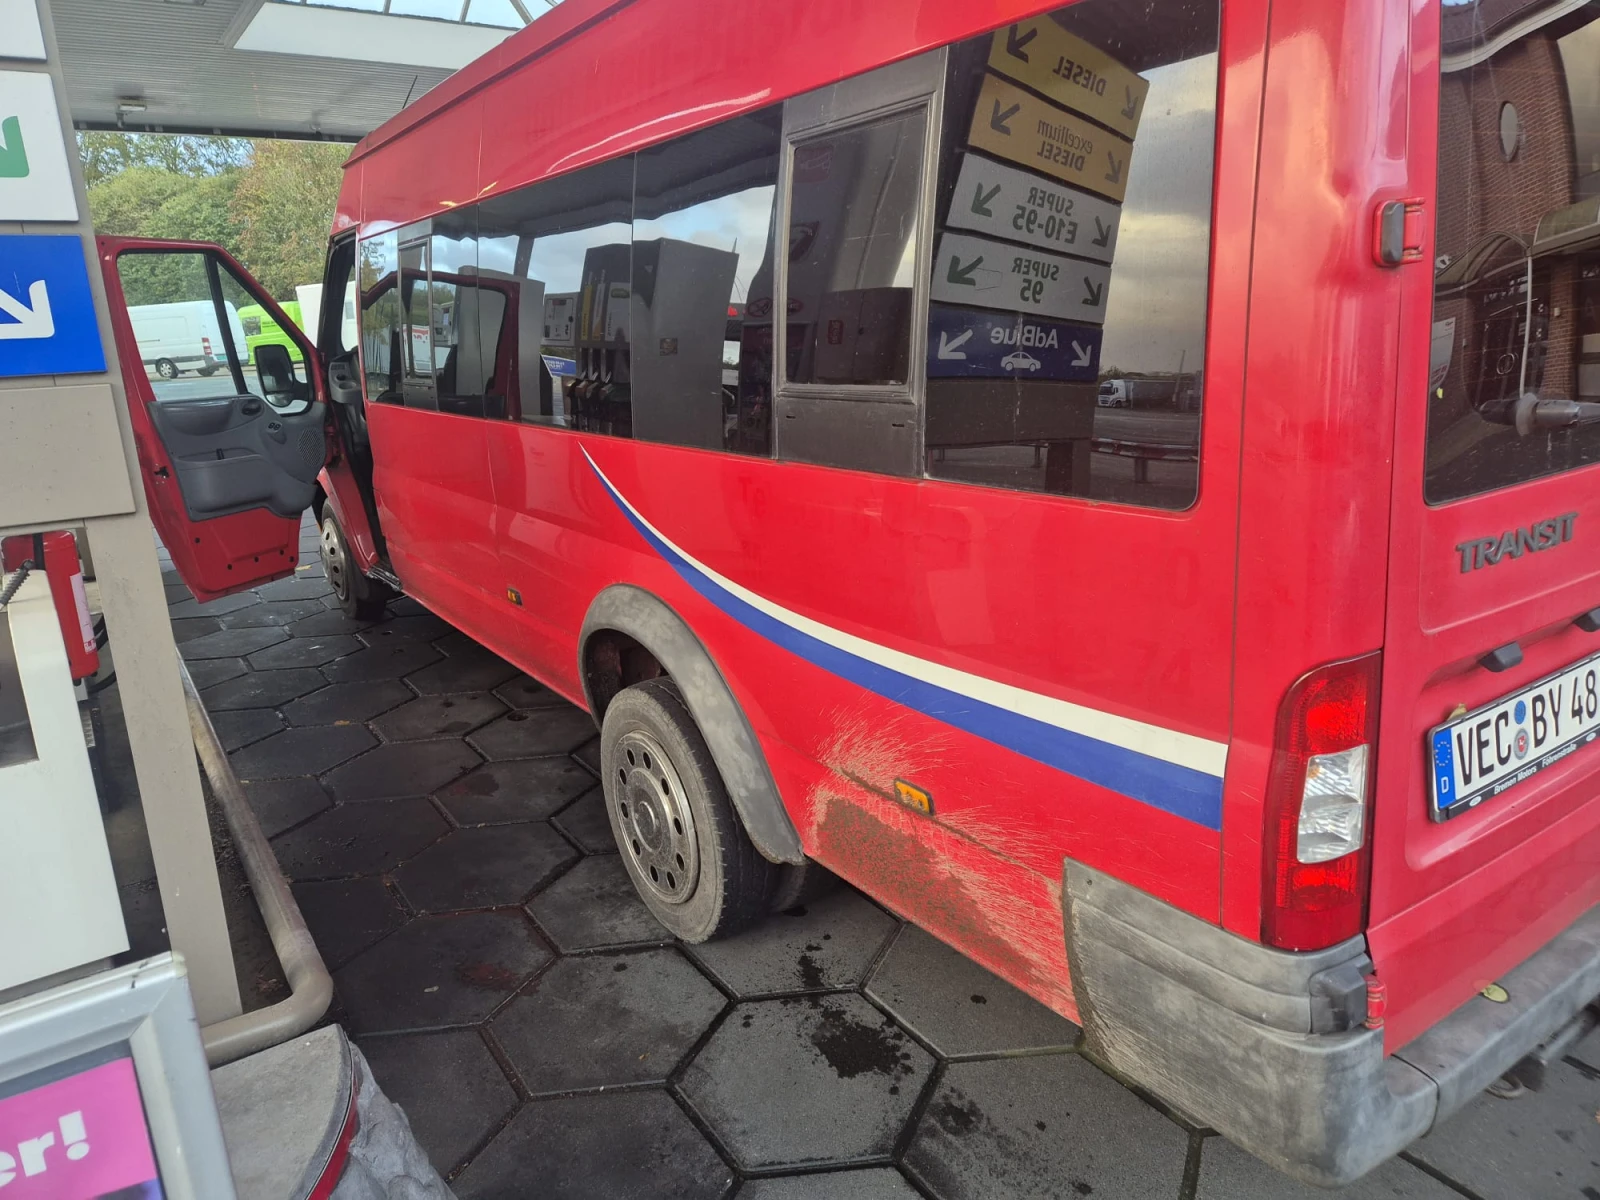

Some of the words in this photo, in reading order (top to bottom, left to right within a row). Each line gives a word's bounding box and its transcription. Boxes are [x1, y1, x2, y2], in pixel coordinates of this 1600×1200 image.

[1456, 511, 1579, 574] TRANSIT
[1457, 710, 1512, 787] VEC
[1531, 684, 1562, 749] BY
[1571, 669, 1598, 725] 48
[1440, 776, 1450, 793] D
[1517, 765, 1537, 782] Motors
